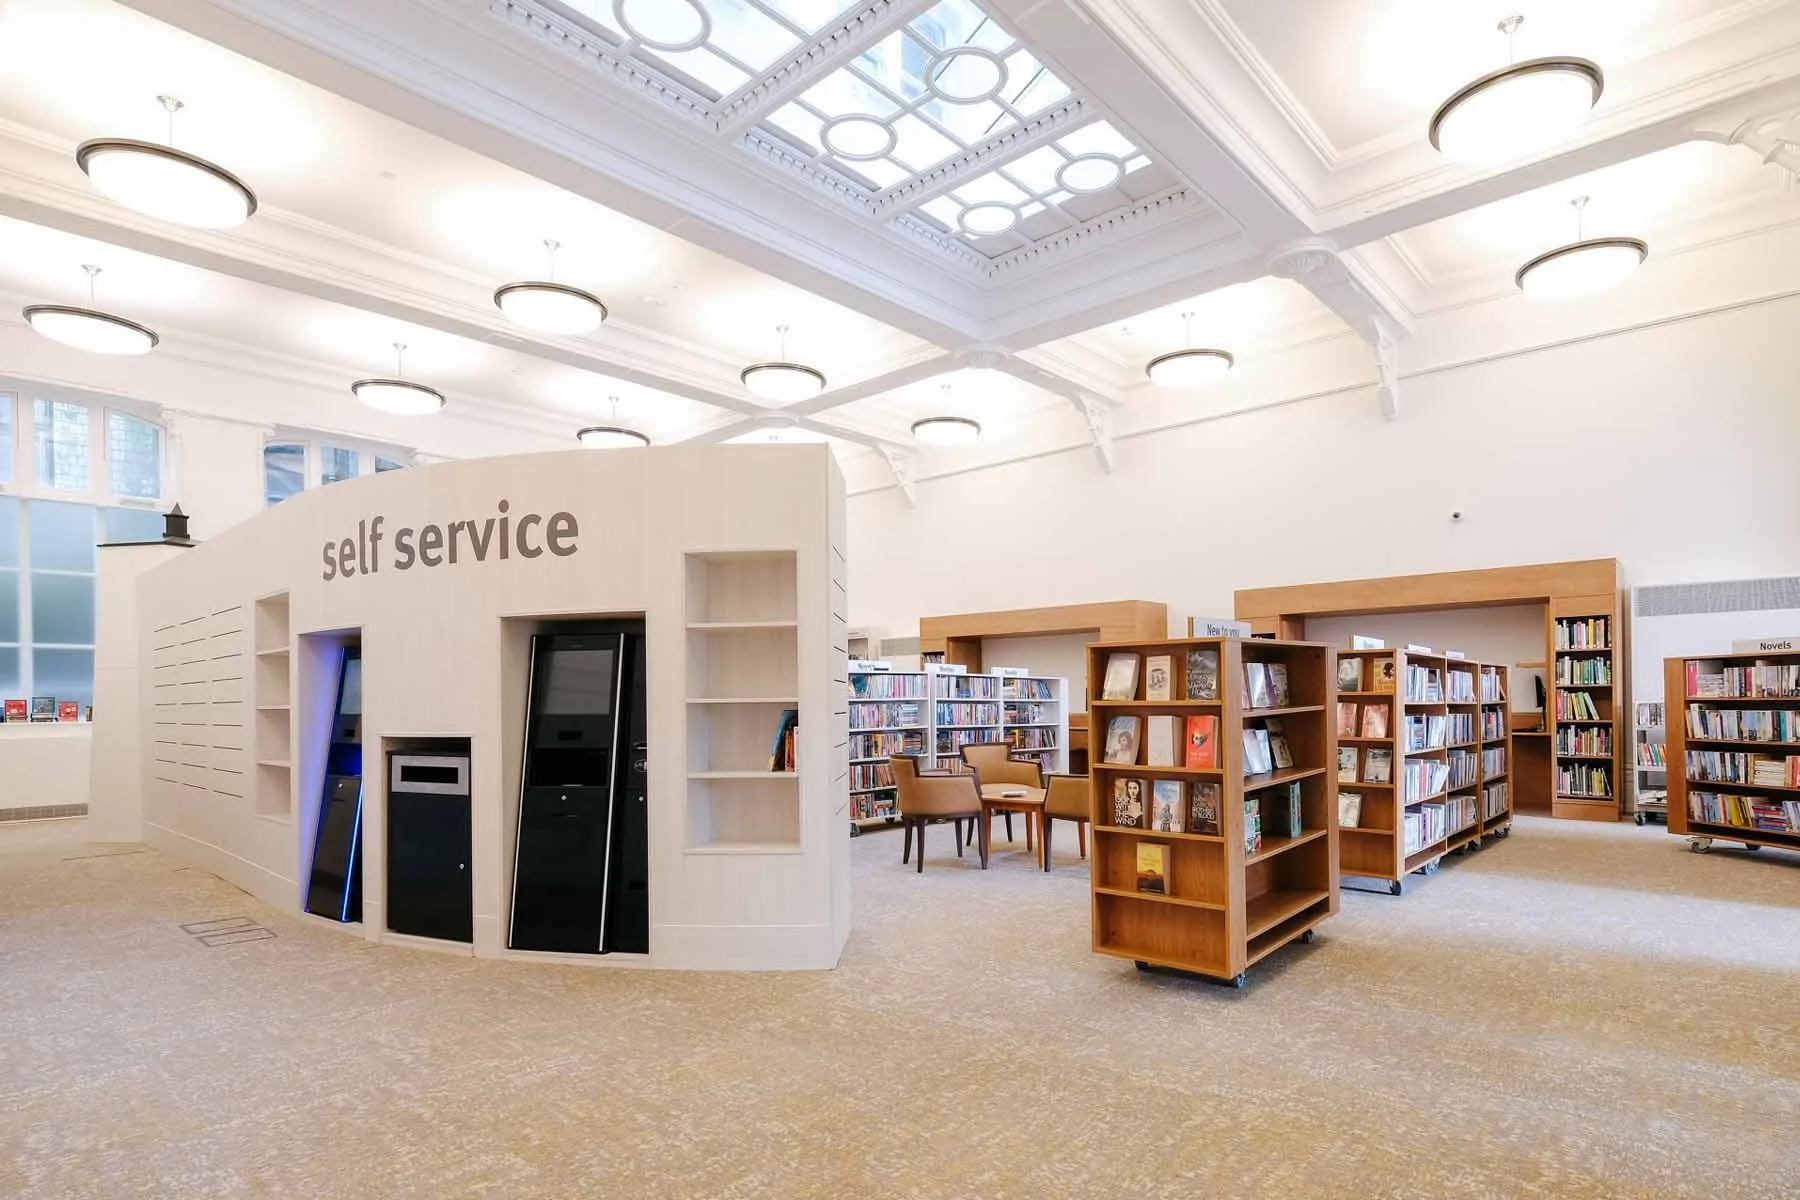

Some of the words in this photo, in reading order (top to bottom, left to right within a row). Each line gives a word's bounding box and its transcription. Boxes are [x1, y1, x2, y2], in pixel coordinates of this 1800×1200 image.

[322, 515, 385, 582] self
[394, 499, 579, 570] service
[1207, 623, 1221, 637] New
[1221, 625, 1229, 637] to
[1760, 641, 1792, 650] Novels
[1115, 816, 1136, 826] WIND
